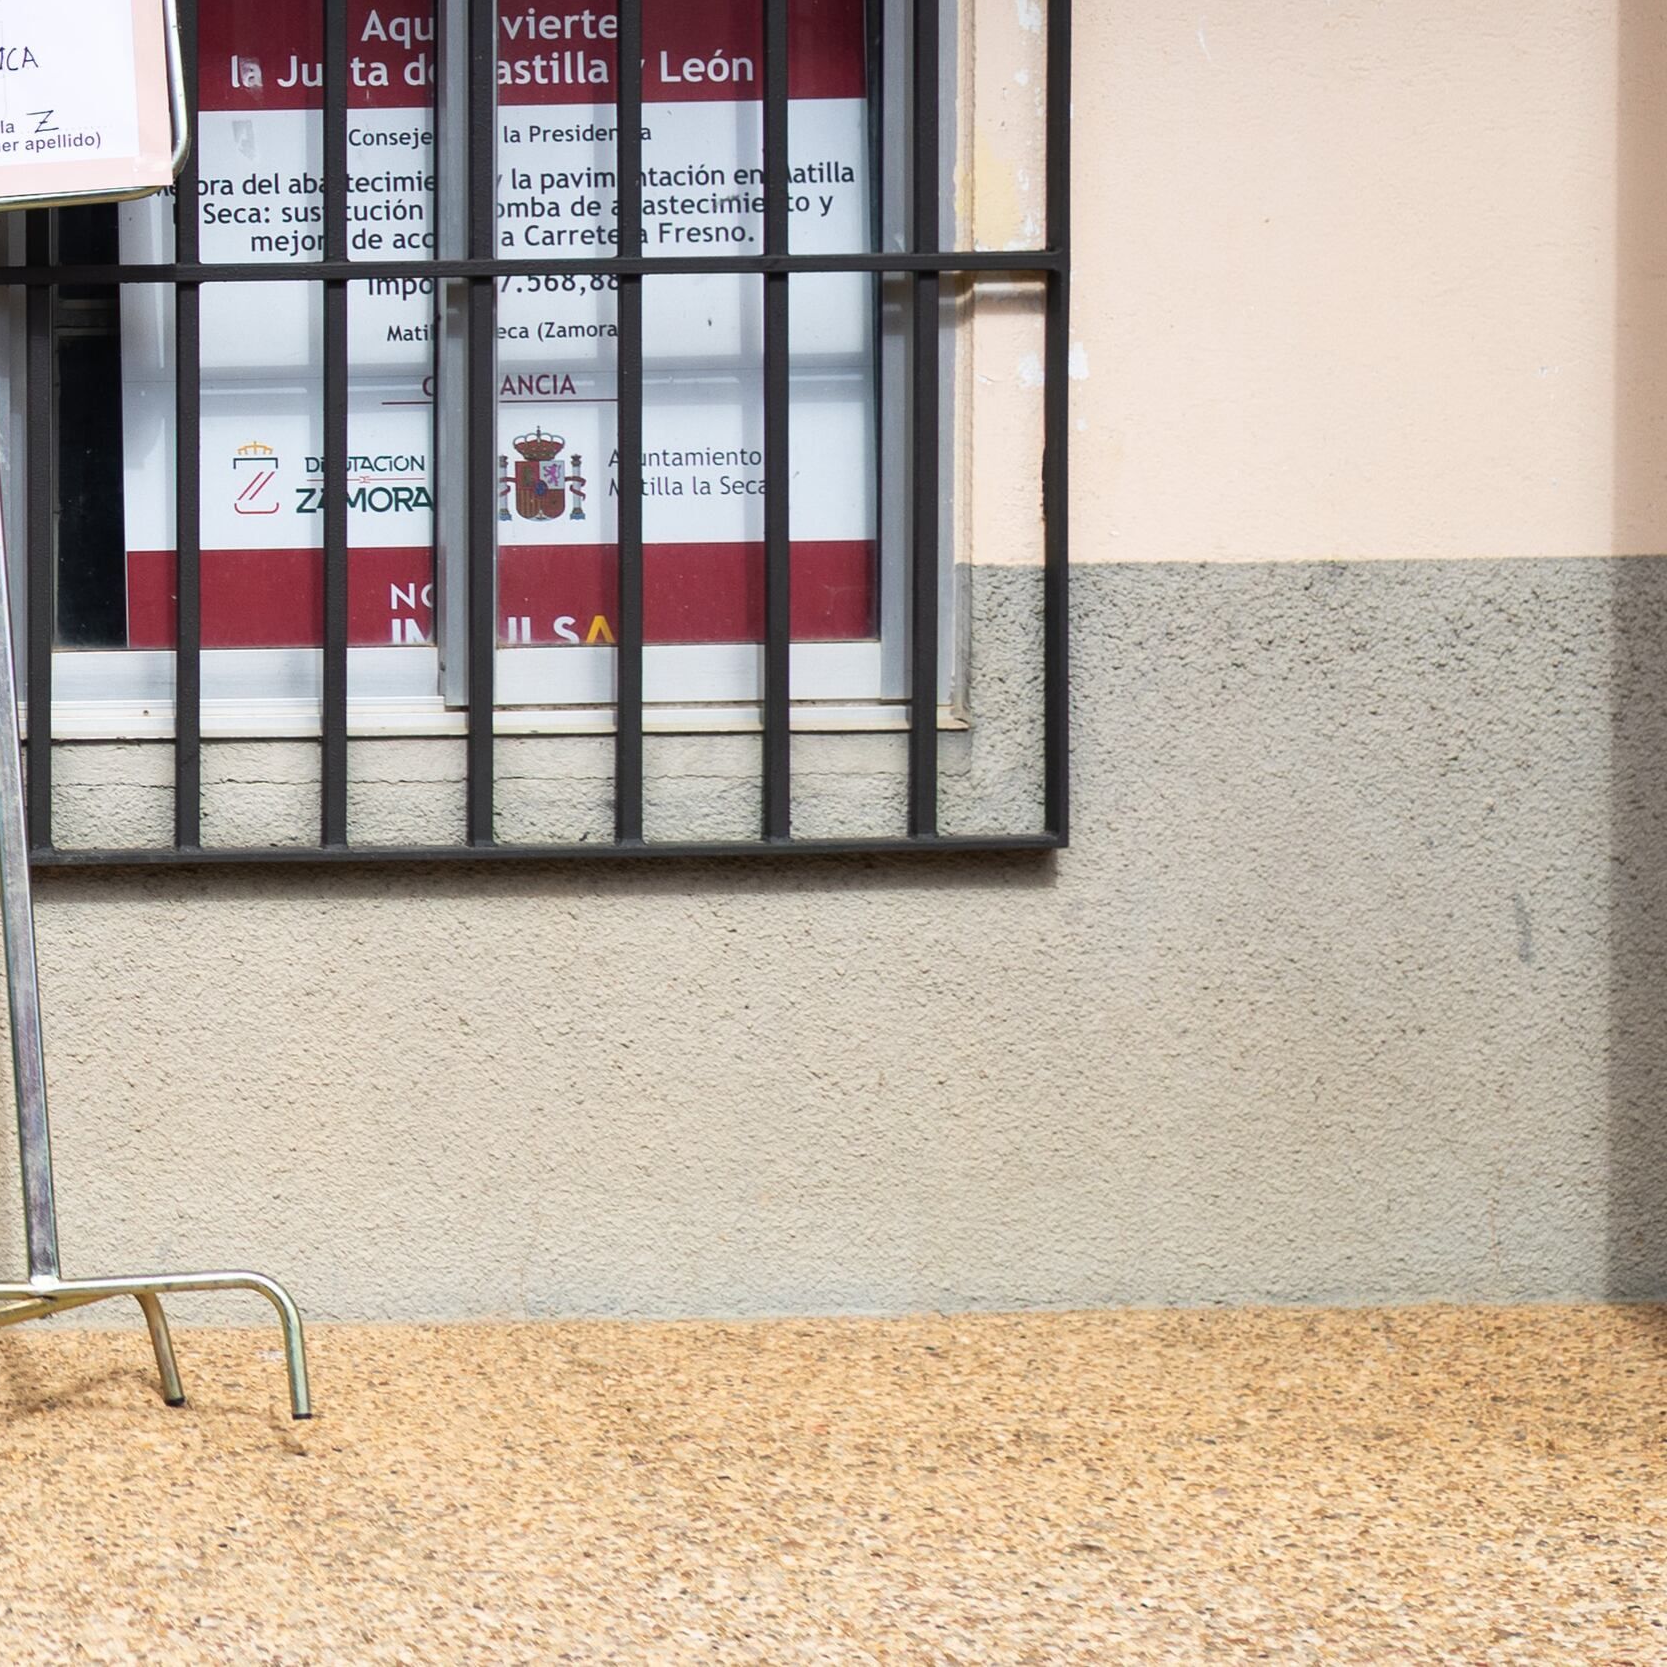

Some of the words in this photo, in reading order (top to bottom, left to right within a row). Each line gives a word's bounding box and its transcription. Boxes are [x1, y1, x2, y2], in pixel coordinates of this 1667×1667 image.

[360, 9, 434, 50] Aqu
[501, 8, 617, 40] vierte
[231, 55, 263, 88] la
[276, 55, 389, 87] Juta
[497, 51, 609, 85] astilla
[660, 49, 754, 83] León
[0, 120, 15, 135] la
[26, 109, 60, 134] Z
[503, 126, 520, 143] la
[529, 124, 652, 143] Presidena
[24, 132, 102, 154] apellido)
[242, 173, 280, 195] del
[511, 168, 532, 190] la
[541, 164, 725, 194] pavimntación
[734, 167, 764, 185] en
[203, 203, 271, 224] Seca:
[497, 196, 560, 219] omba
[571, 196, 601, 216] de
[820, 195, 834, 217] y
[251, 230, 324, 256] mejor
[352, 228, 383, 249] de
[501, 230, 514, 247] a
[524, 224, 649, 246] Carretea
[659, 222, 755, 244] Fresno.
[497, 325, 530, 340] eca
[609, 476, 683, 496] Mtilla
[693, 476, 711, 495] la
[720, 475, 766, 495] Seca
